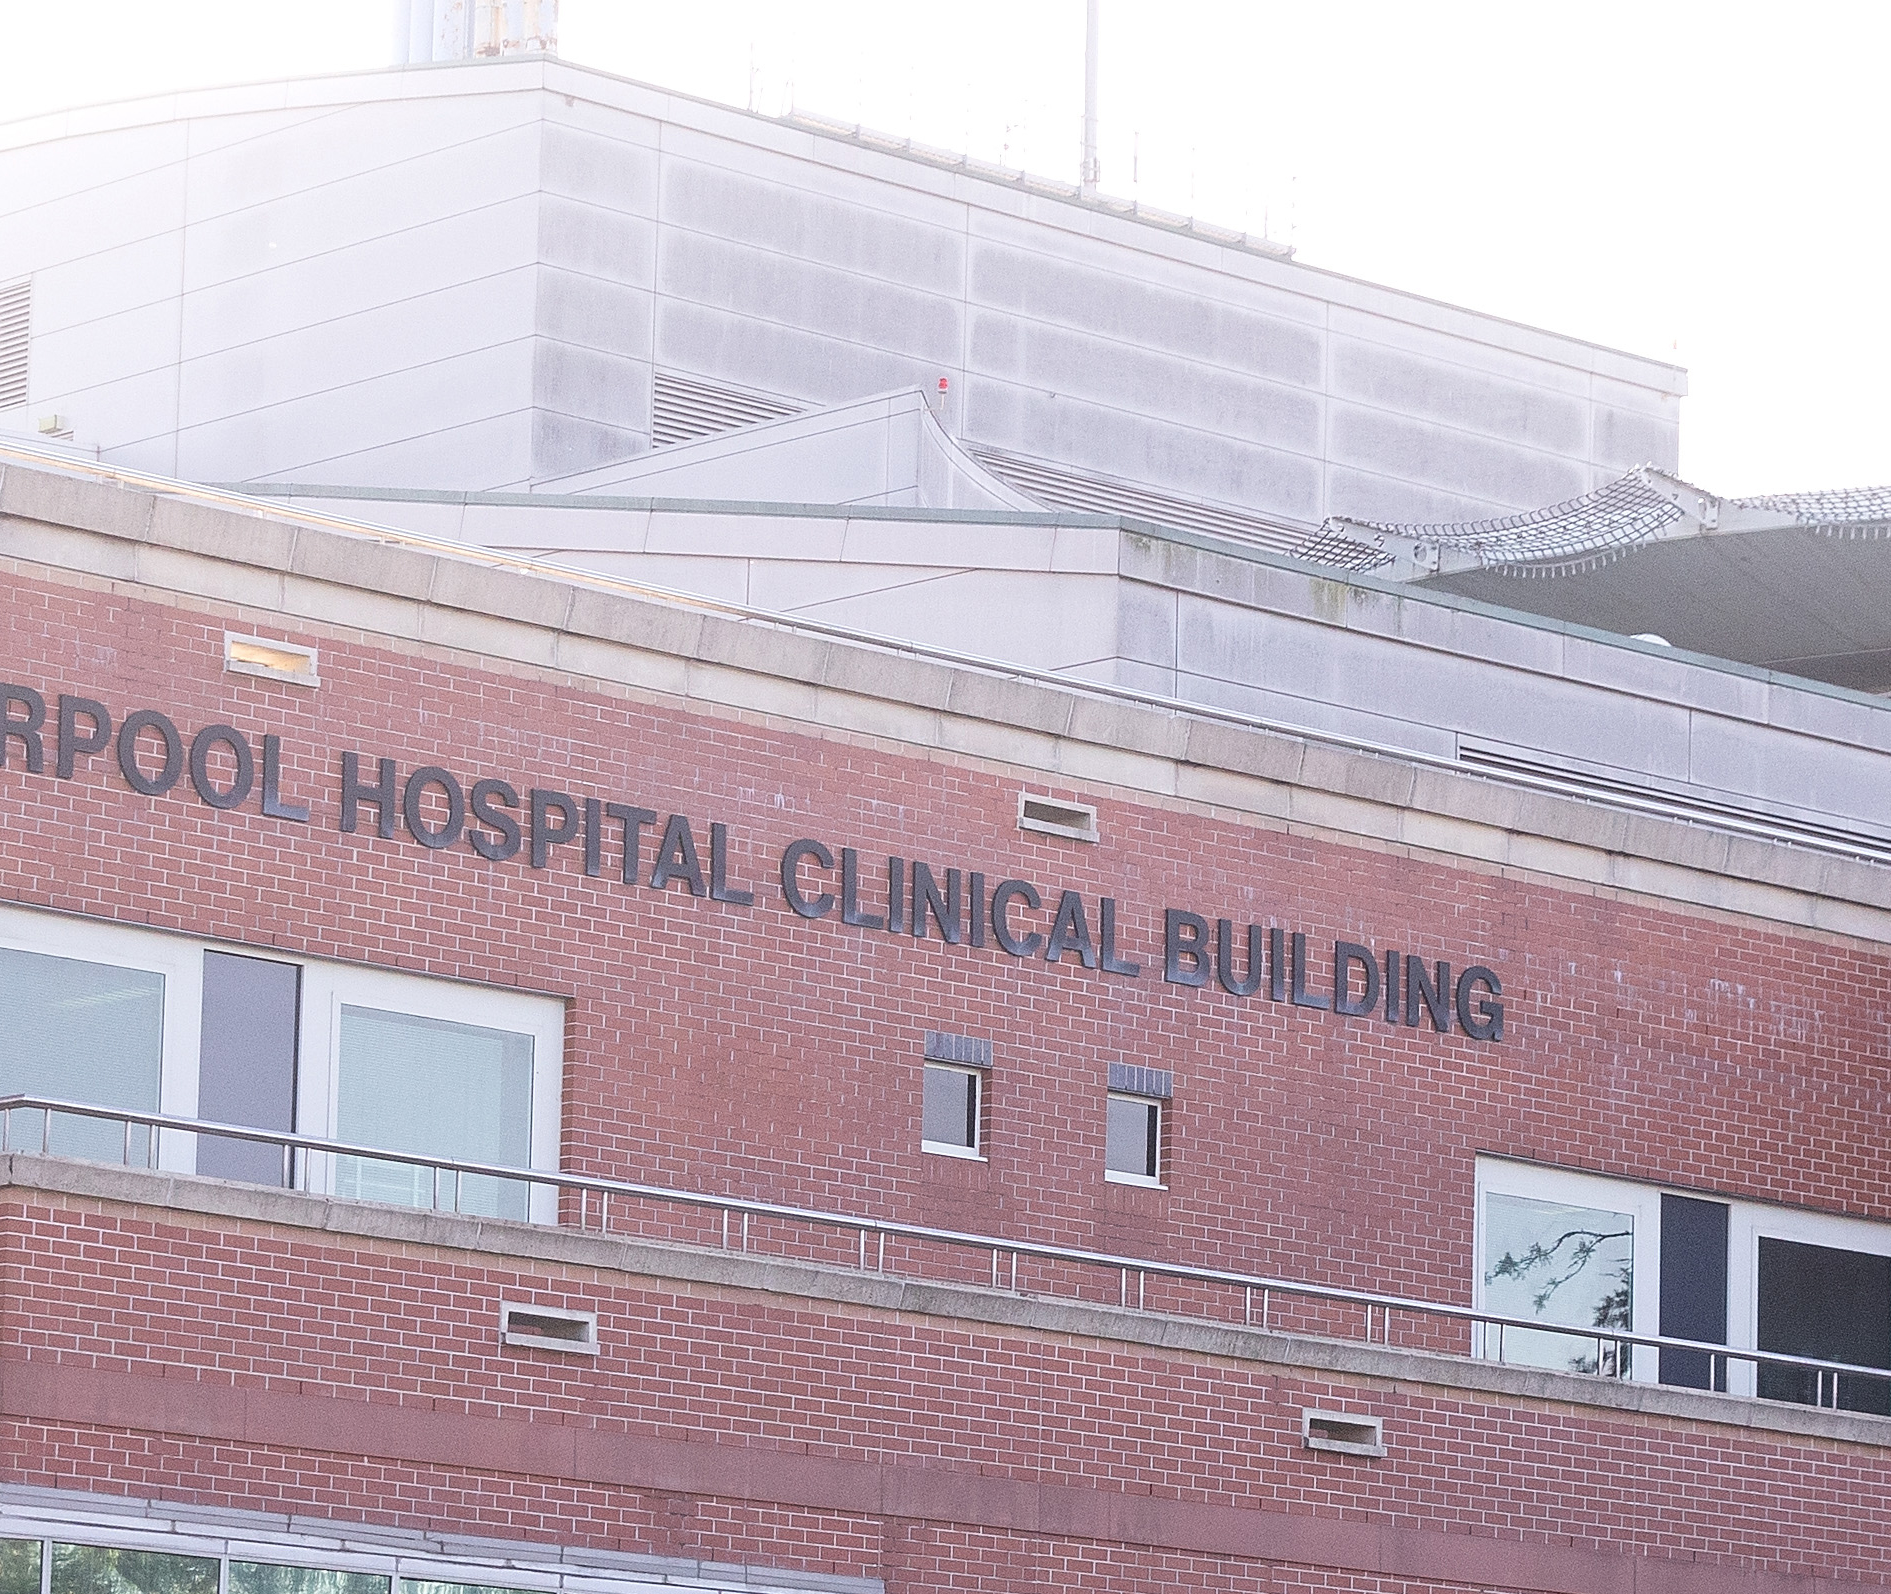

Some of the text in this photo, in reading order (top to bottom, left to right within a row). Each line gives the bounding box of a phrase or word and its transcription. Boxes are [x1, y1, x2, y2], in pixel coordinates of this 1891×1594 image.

[341, 751, 753, 907] HOSPITAL
[782, 837, 1140, 977] CLINICAL
[1165, 908, 1504, 1041] BUILDING
